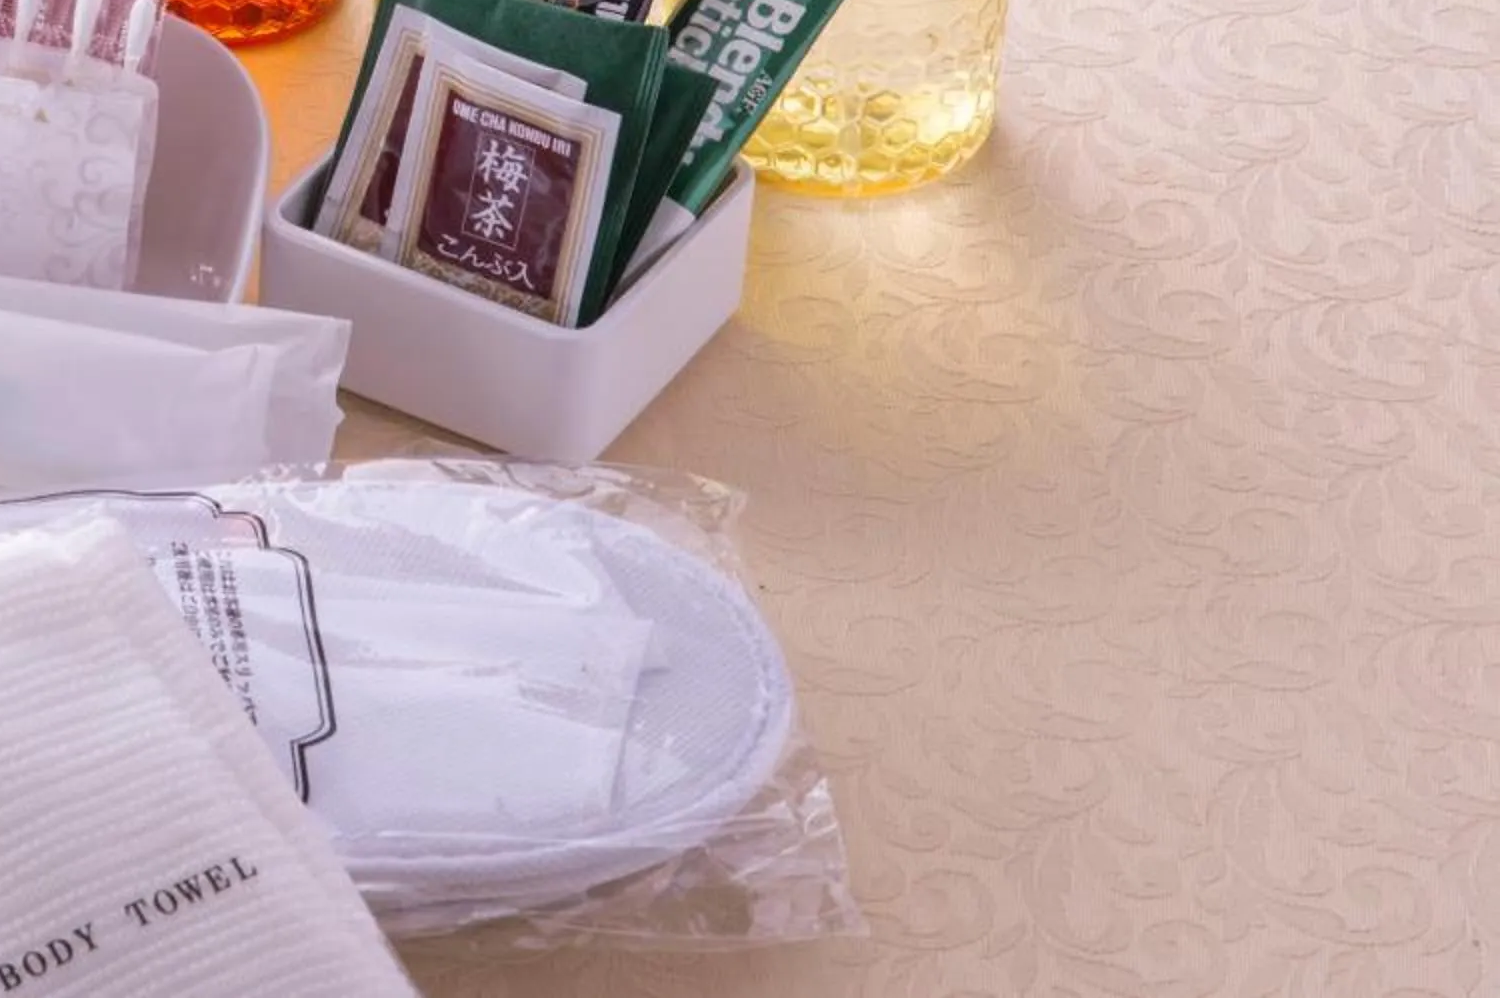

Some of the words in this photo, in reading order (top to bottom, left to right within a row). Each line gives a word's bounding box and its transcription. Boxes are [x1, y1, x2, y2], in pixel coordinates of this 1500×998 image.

[471, 139, 528, 238] 梅茶
[437, 234, 535, 290] こんぶ入
[123, 857, 258, 927] TOWEL
